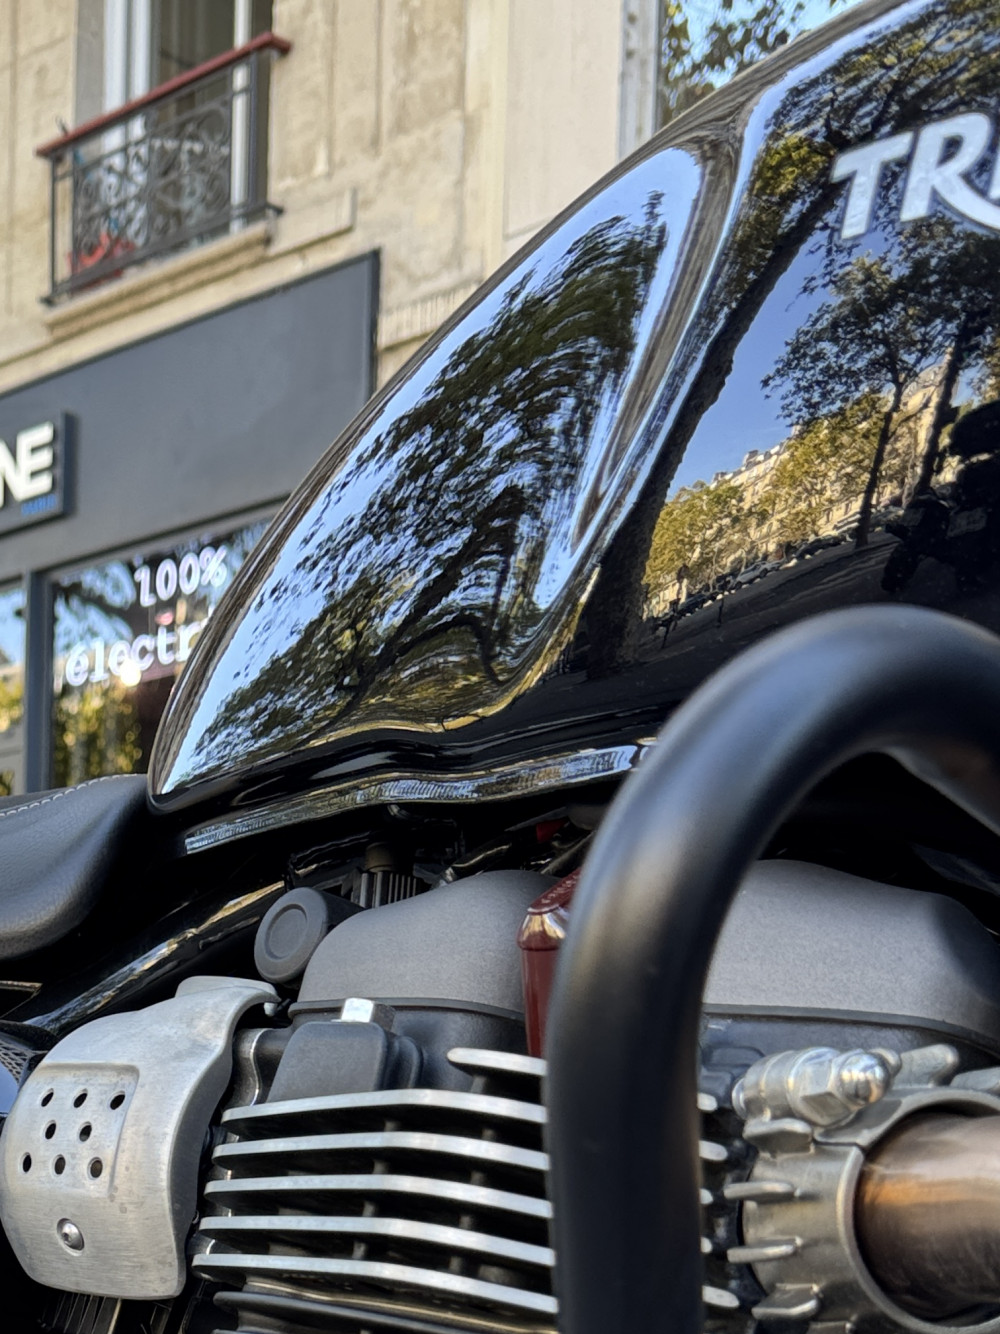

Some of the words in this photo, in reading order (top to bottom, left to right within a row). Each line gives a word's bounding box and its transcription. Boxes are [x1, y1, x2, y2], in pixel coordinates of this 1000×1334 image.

[831, 112, 1000, 241] TR
[134, 546, 228, 608] 100%
[65, 614, 210, 687] électr
